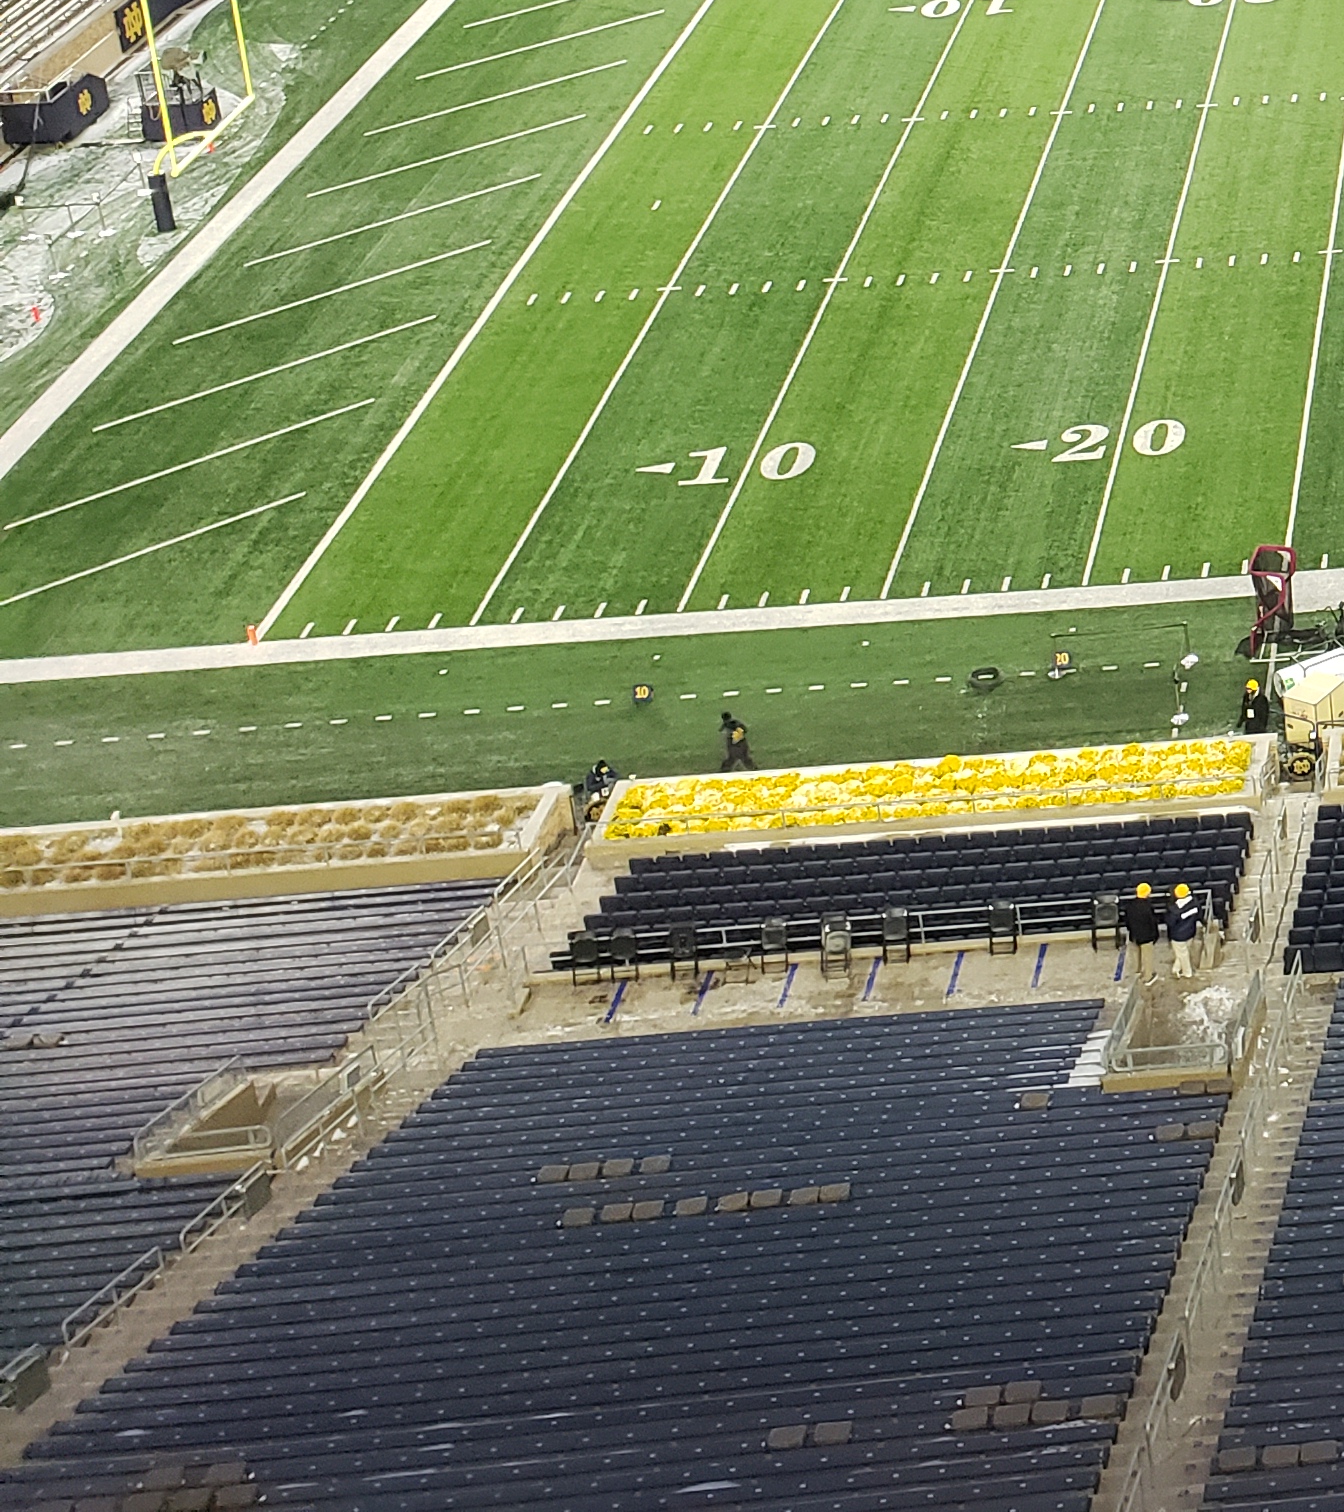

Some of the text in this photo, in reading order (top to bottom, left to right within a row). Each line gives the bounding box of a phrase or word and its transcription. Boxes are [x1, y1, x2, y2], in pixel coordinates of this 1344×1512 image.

[1052, 419, 1186, 463] 20
[677, 442, 816, 486] 10
[1055, 652, 1069, 665] 20
[634, 686, 649, 699] 10
